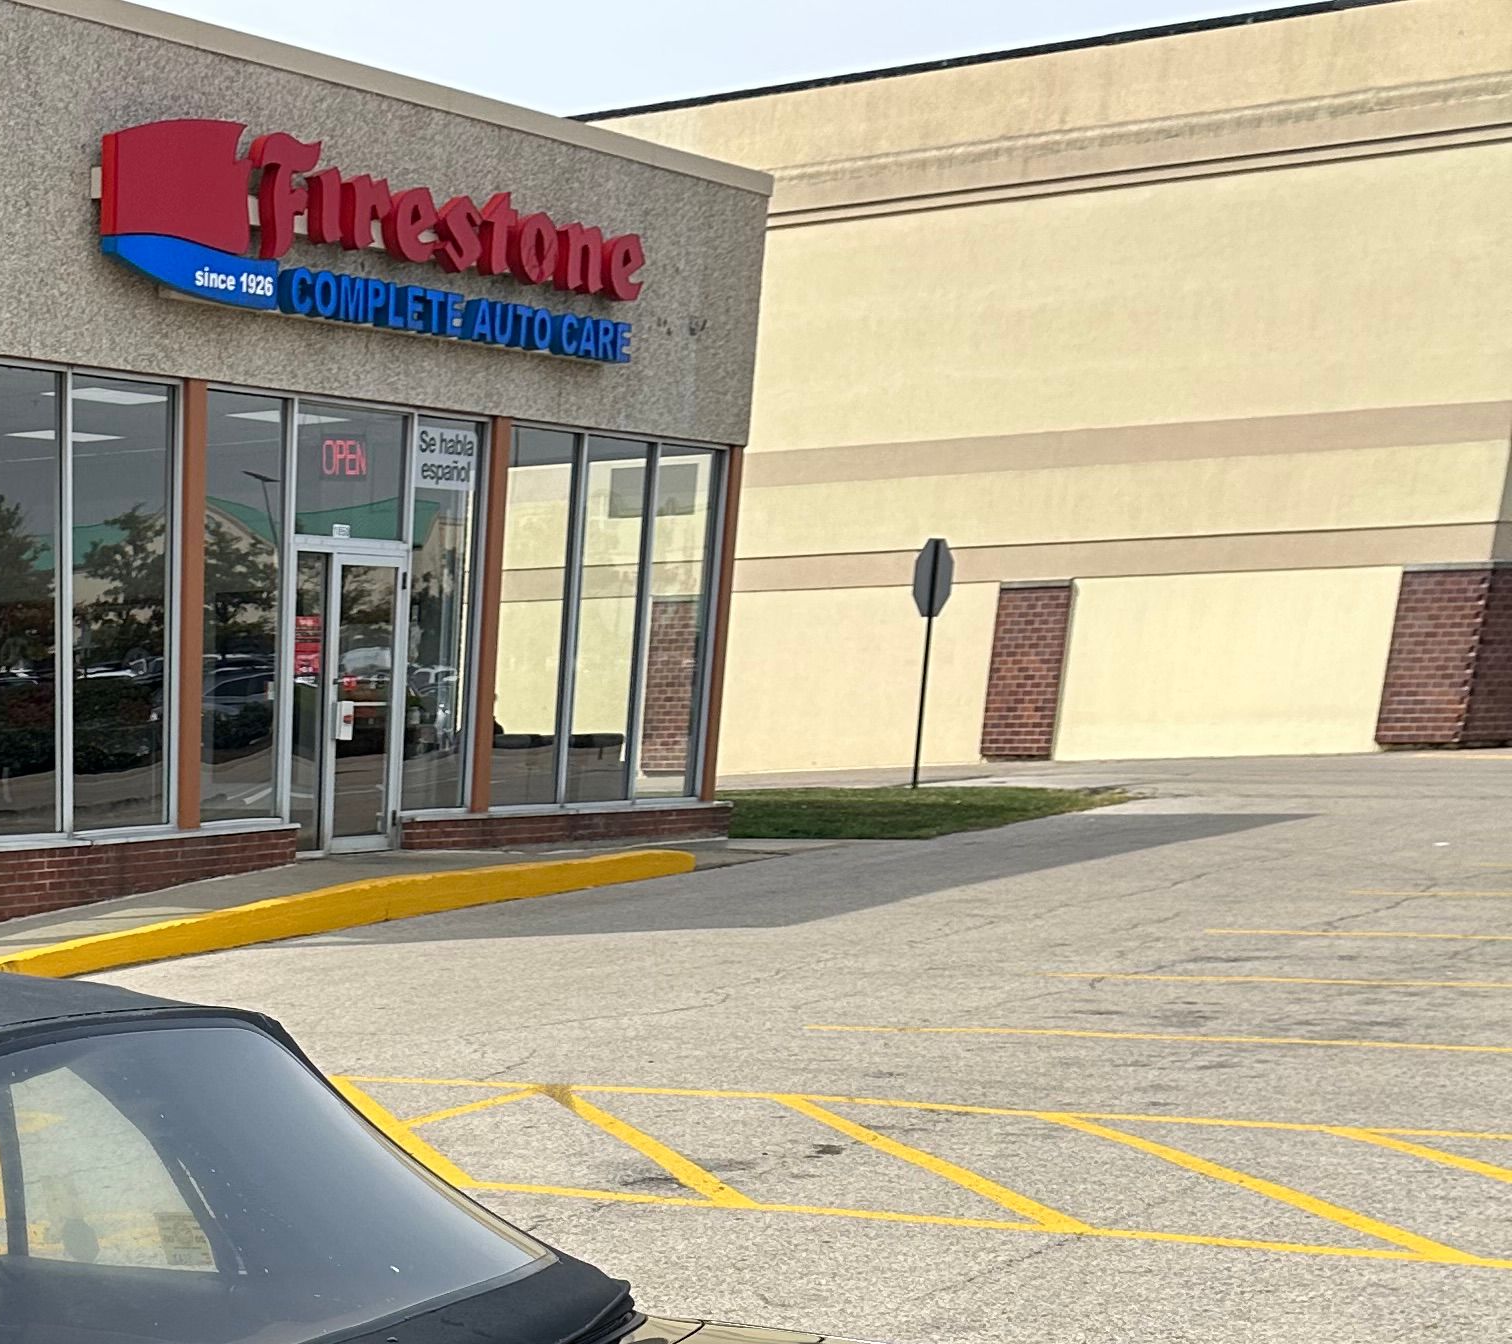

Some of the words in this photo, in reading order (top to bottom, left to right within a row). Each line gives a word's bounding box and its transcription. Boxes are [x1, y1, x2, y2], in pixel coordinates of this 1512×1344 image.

[251, 132, 646, 300] Firestone
[195, 267, 236, 291] since
[240, 273, 274, 296] 1926
[289, 267, 465, 337] COMPLETE
[471, 301, 552, 350] AUTO
[561, 313, 632, 363] CARE
[322, 439, 367, 476] OPEN
[419, 430, 437, 454] Se
[439, 432, 474, 457] habla
[421, 460, 472, 485] español
